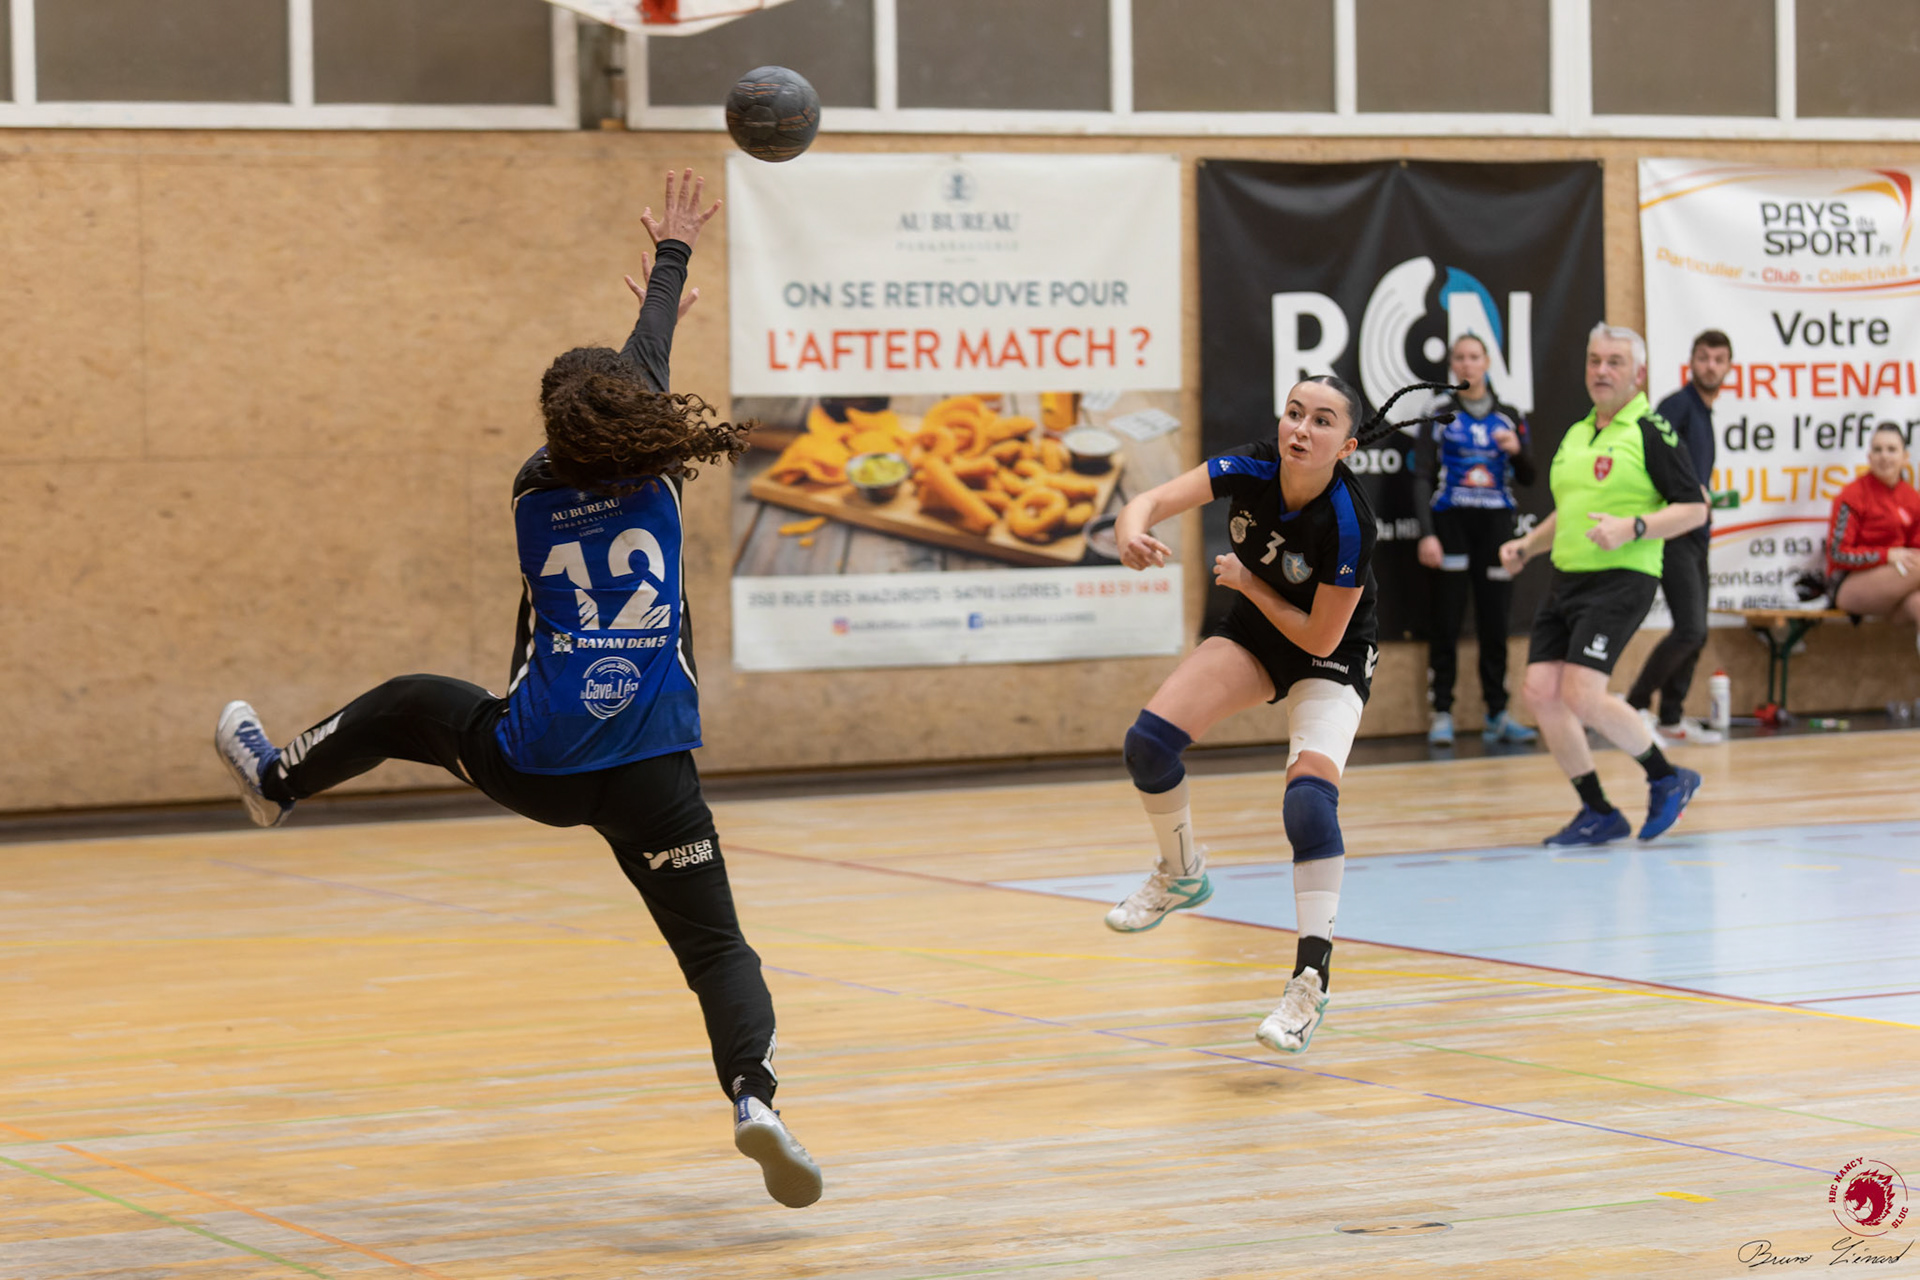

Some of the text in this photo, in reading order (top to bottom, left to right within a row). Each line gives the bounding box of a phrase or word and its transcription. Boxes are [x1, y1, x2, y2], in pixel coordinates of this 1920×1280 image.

[895, 211, 1021, 232] AU BUREAU
[1760, 202, 1850, 228] PAYS
[1656, 246, 1743, 279] Particulier
[1762, 267, 1801, 284] Club
[783, 280, 1129, 309] ON SE RETROUVE POUR
[1771, 310, 1890, 347] Votre
[767, 326, 1152, 372] L'AFTER MATCH ?
[1724, 412, 1920, 451] de l'effr
[1345, 447, 1402, 474] DIO
[551, 497, 621, 522] AU BUREAU
[1260, 530, 1286, 566] 3
[1749, 538, 1777, 557] 03
[540, 527, 671, 631] 12
[577, 636, 626, 649] RAYAN
[1311, 657, 1350, 675] hummel
[586, 679, 612, 700] Cave
[669, 838, 712, 859] INTER
[672, 849, 714, 869] SPORT
